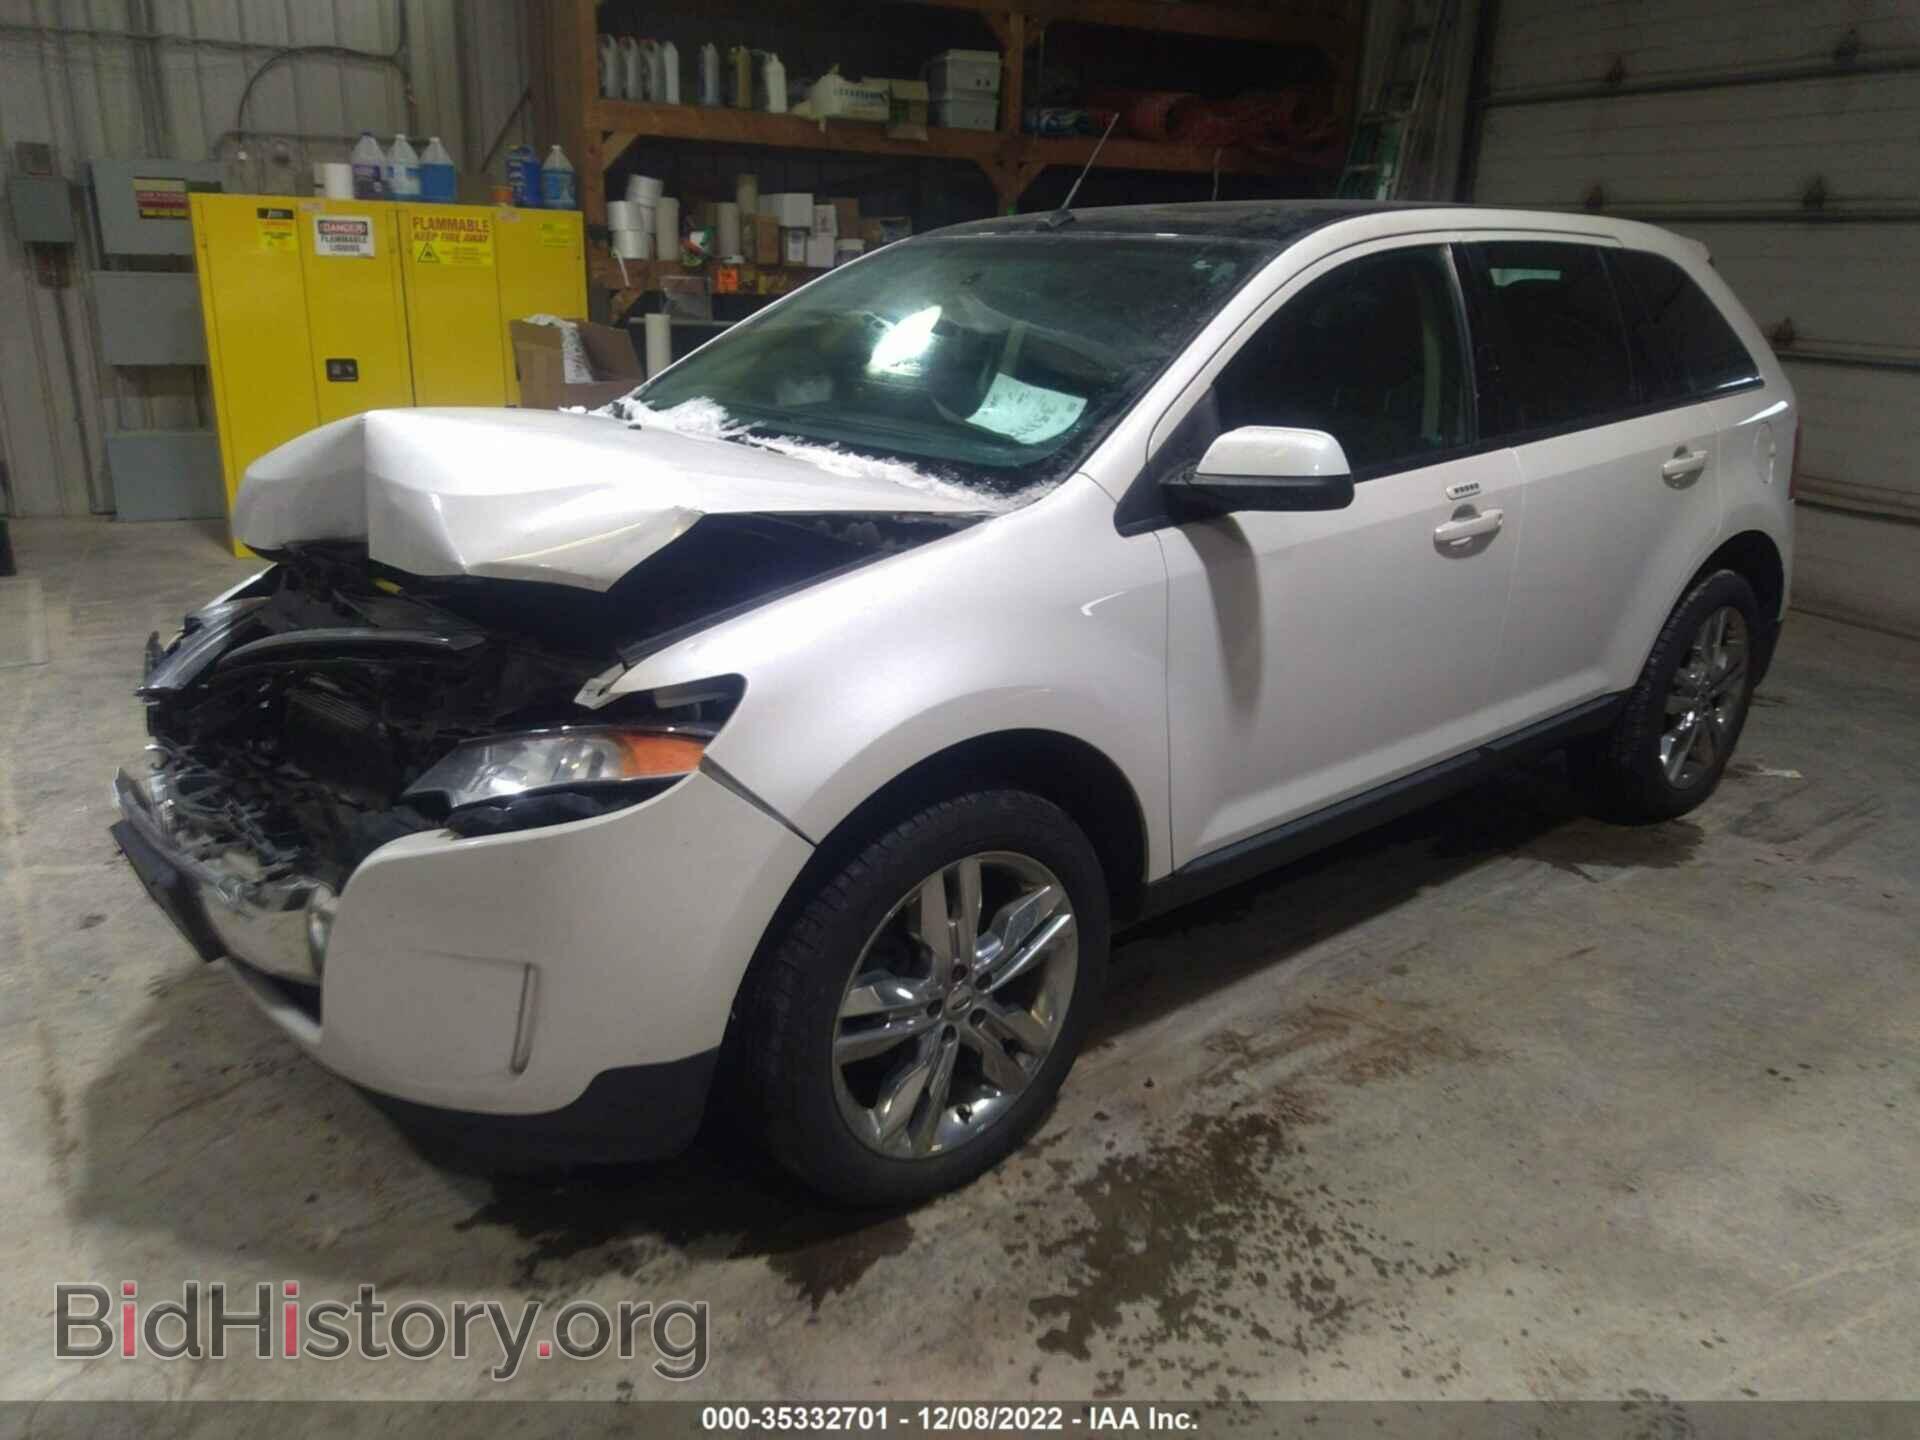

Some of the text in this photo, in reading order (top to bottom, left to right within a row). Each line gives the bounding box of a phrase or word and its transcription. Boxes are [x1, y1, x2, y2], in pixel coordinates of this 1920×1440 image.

[320, 222, 366, 234] DANGER
[412, 216, 489, 232] FLAMMABLE
[320, 234, 367, 243] FLAMMABLE
[414, 231, 489, 242] KEEP FIRE AWAY
